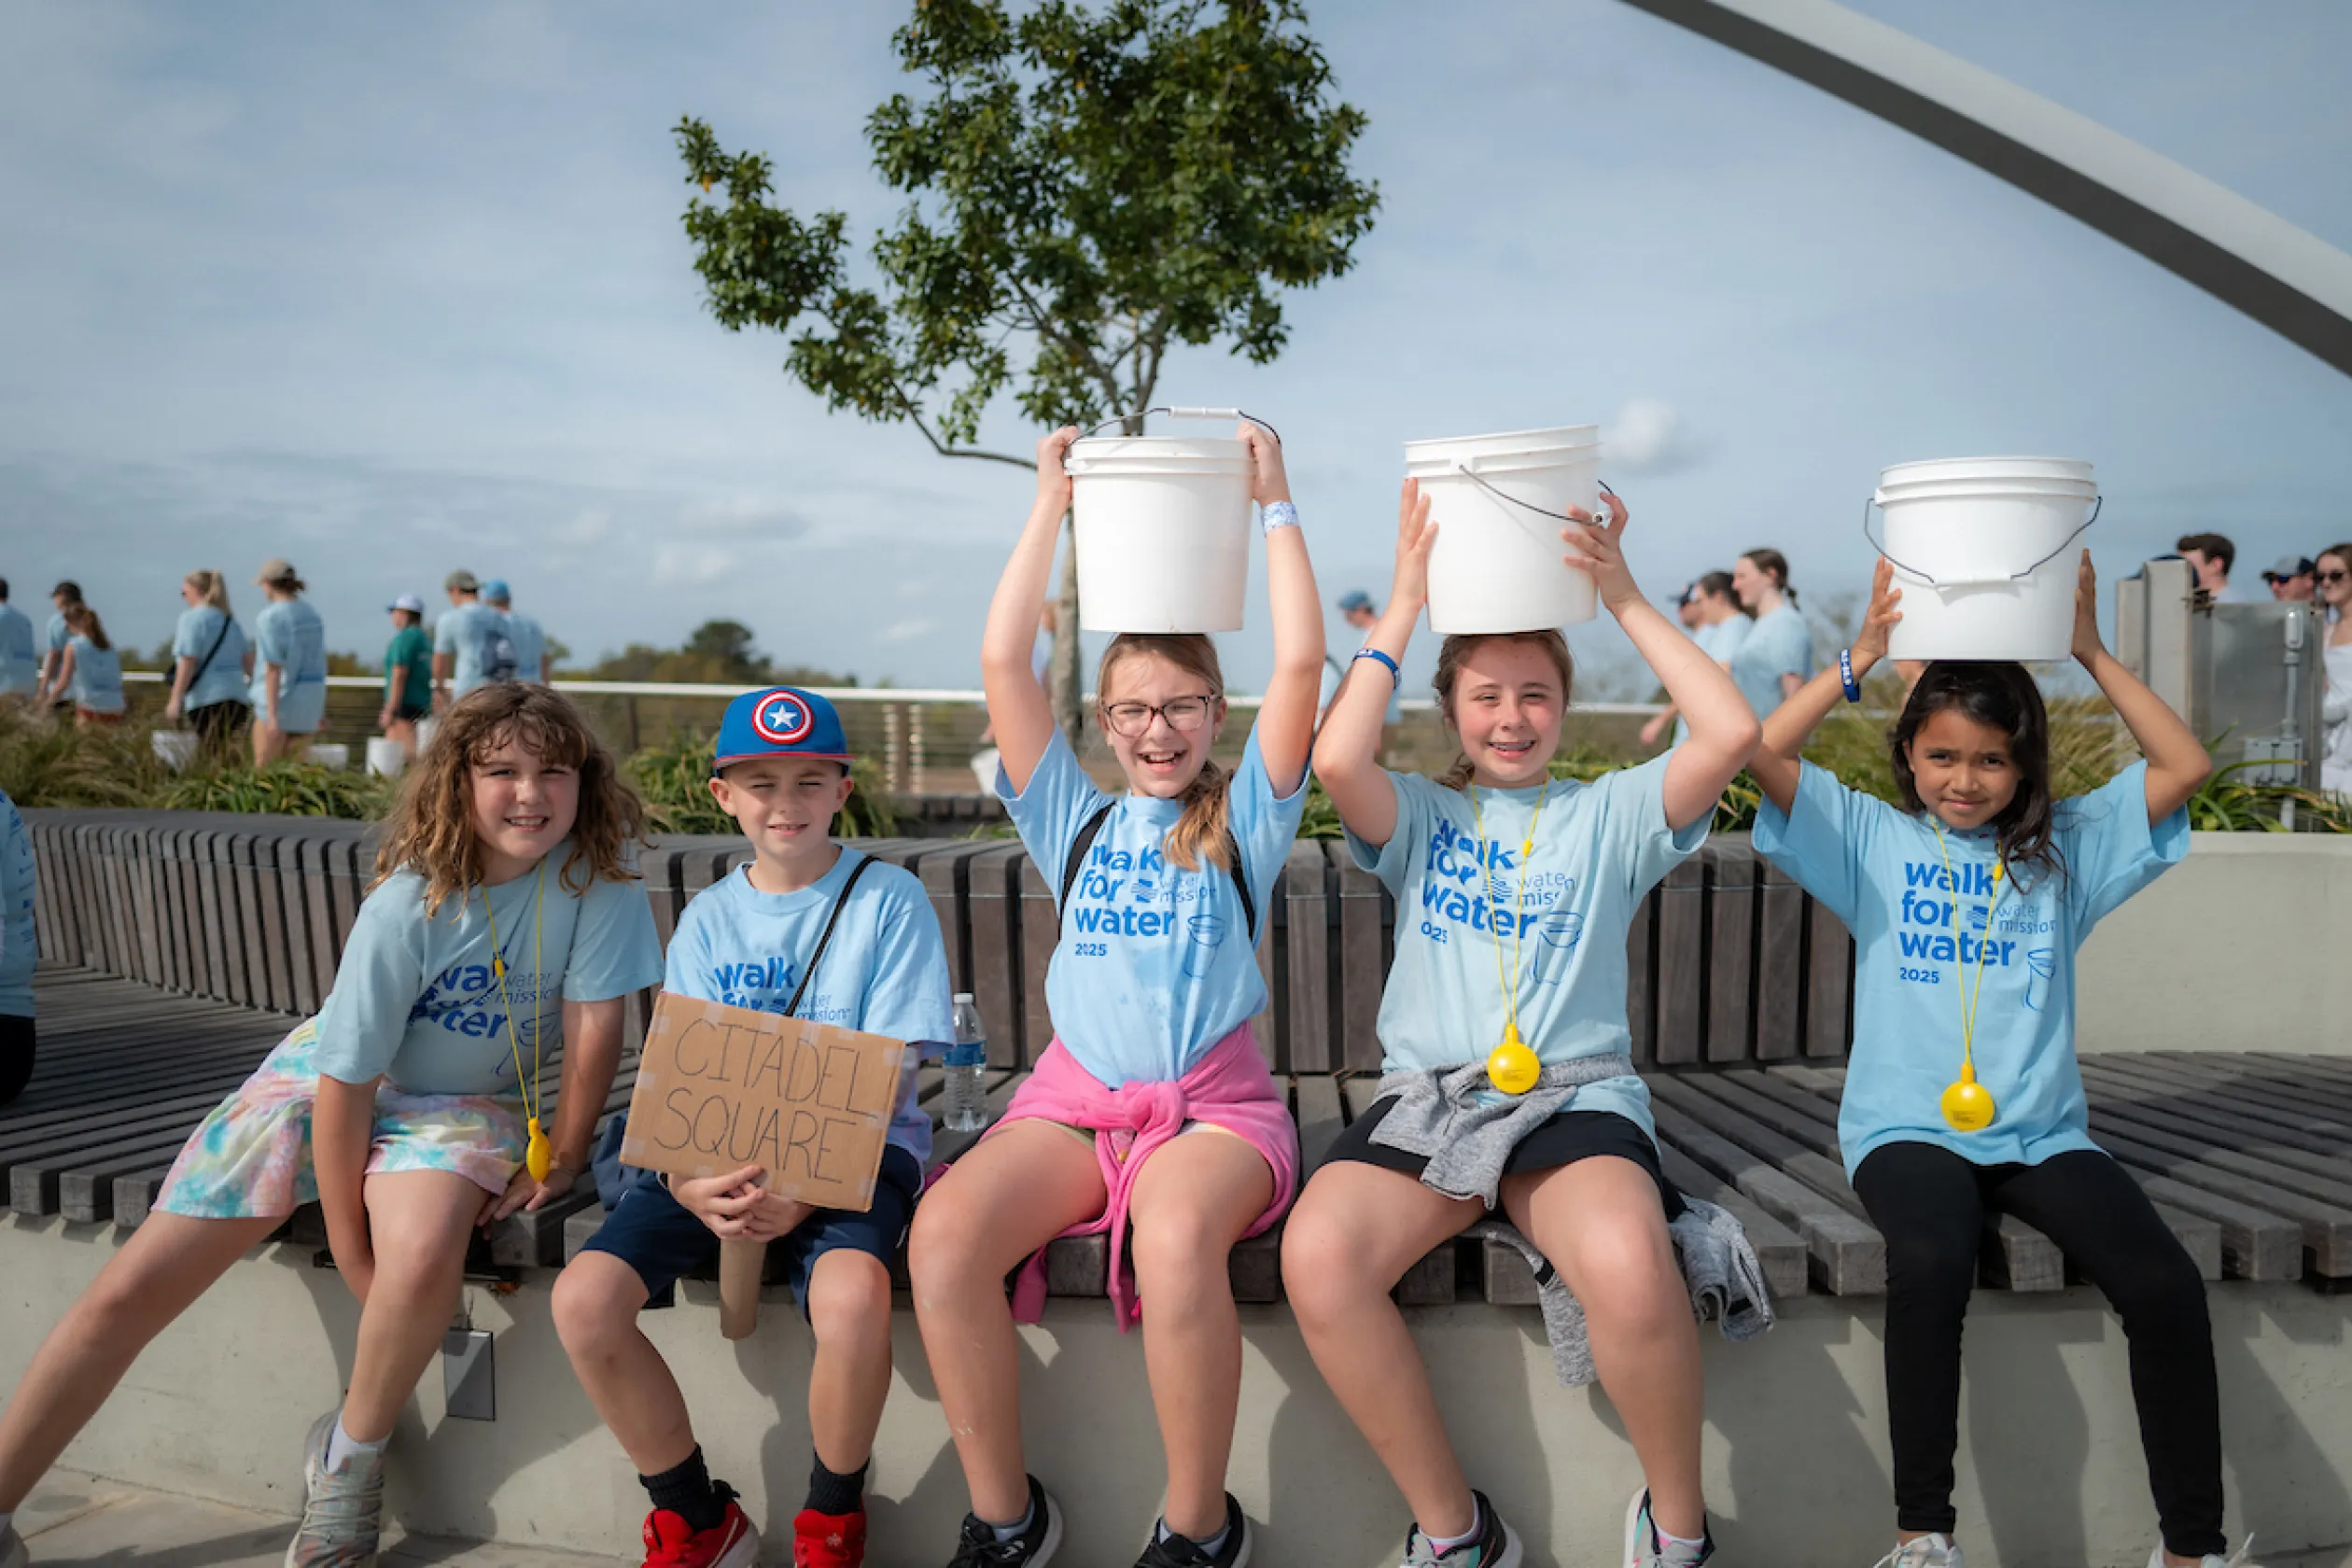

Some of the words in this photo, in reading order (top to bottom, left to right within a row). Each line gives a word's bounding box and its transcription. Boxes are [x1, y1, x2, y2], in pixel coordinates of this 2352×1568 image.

[1090, 844, 1161, 872] wak
[1434, 816, 1517, 871] walk
[1078, 869, 1126, 903] for
[1517, 871, 1566, 889] wate
[1905, 862, 1995, 898] walk
[1074, 905, 1177, 937] water
[1422, 880, 1539, 940] water
[1901, 889, 1957, 927] for
[1898, 931, 2017, 967] water
[714, 957, 795, 992] walk
[1899, 967, 1940, 985] 2025
[674, 1017, 878, 1119] CITADEL
[652, 1086, 858, 1184] SQUARE
